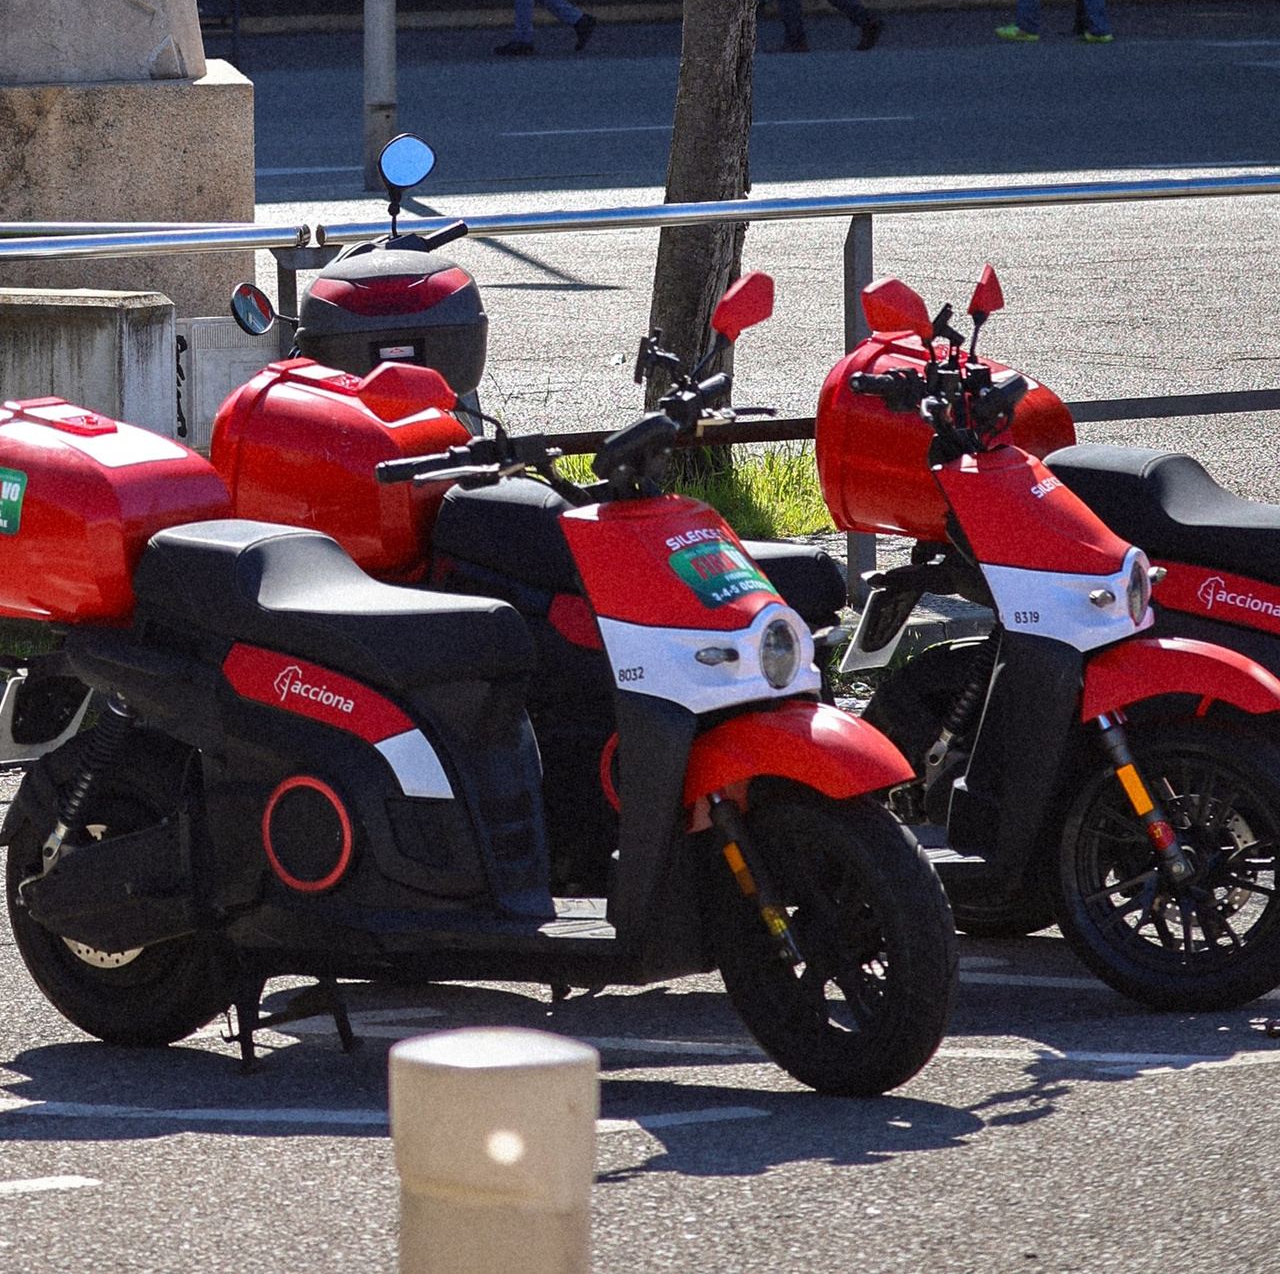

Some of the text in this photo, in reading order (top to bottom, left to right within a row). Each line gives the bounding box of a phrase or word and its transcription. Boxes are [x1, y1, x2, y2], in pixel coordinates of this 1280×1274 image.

[1216, 590, 1280, 618] acciona
[1013, 610, 1040, 624] 8319
[618, 666, 645, 683] 8032
[290, 680, 355, 714] acciona
